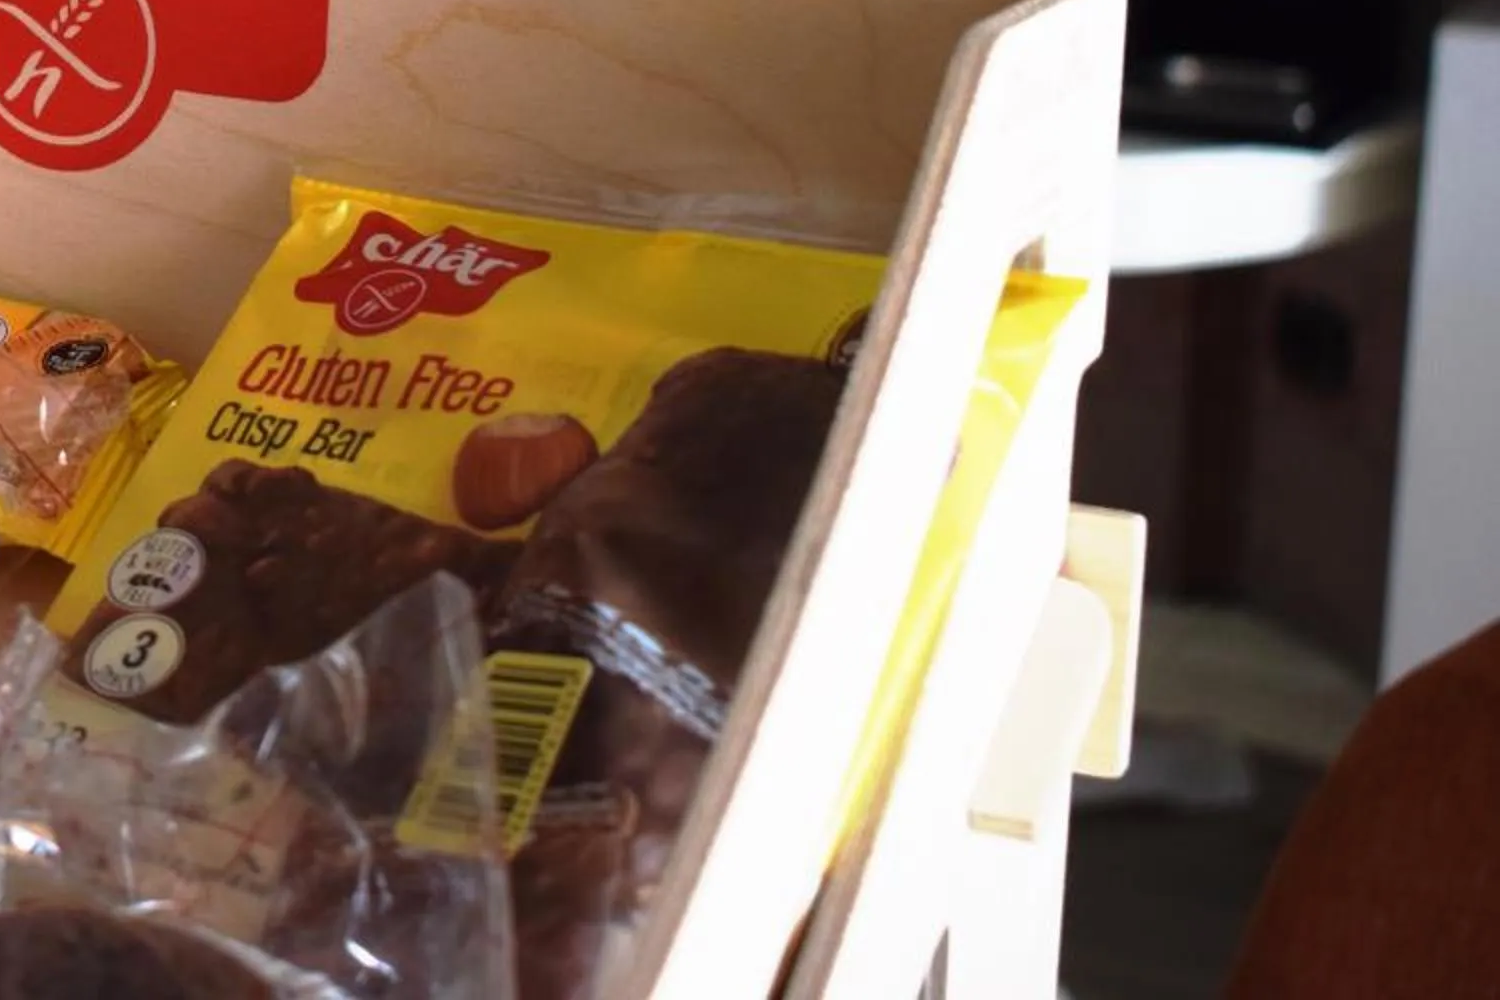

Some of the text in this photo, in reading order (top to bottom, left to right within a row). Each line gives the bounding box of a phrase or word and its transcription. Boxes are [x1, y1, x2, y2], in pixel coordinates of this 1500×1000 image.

[362, 231, 518, 287] chär
[236, 344, 514, 416] Gluten Free
[206, 402, 375, 462] Crisp Bar
[122, 629, 159, 669] 3
